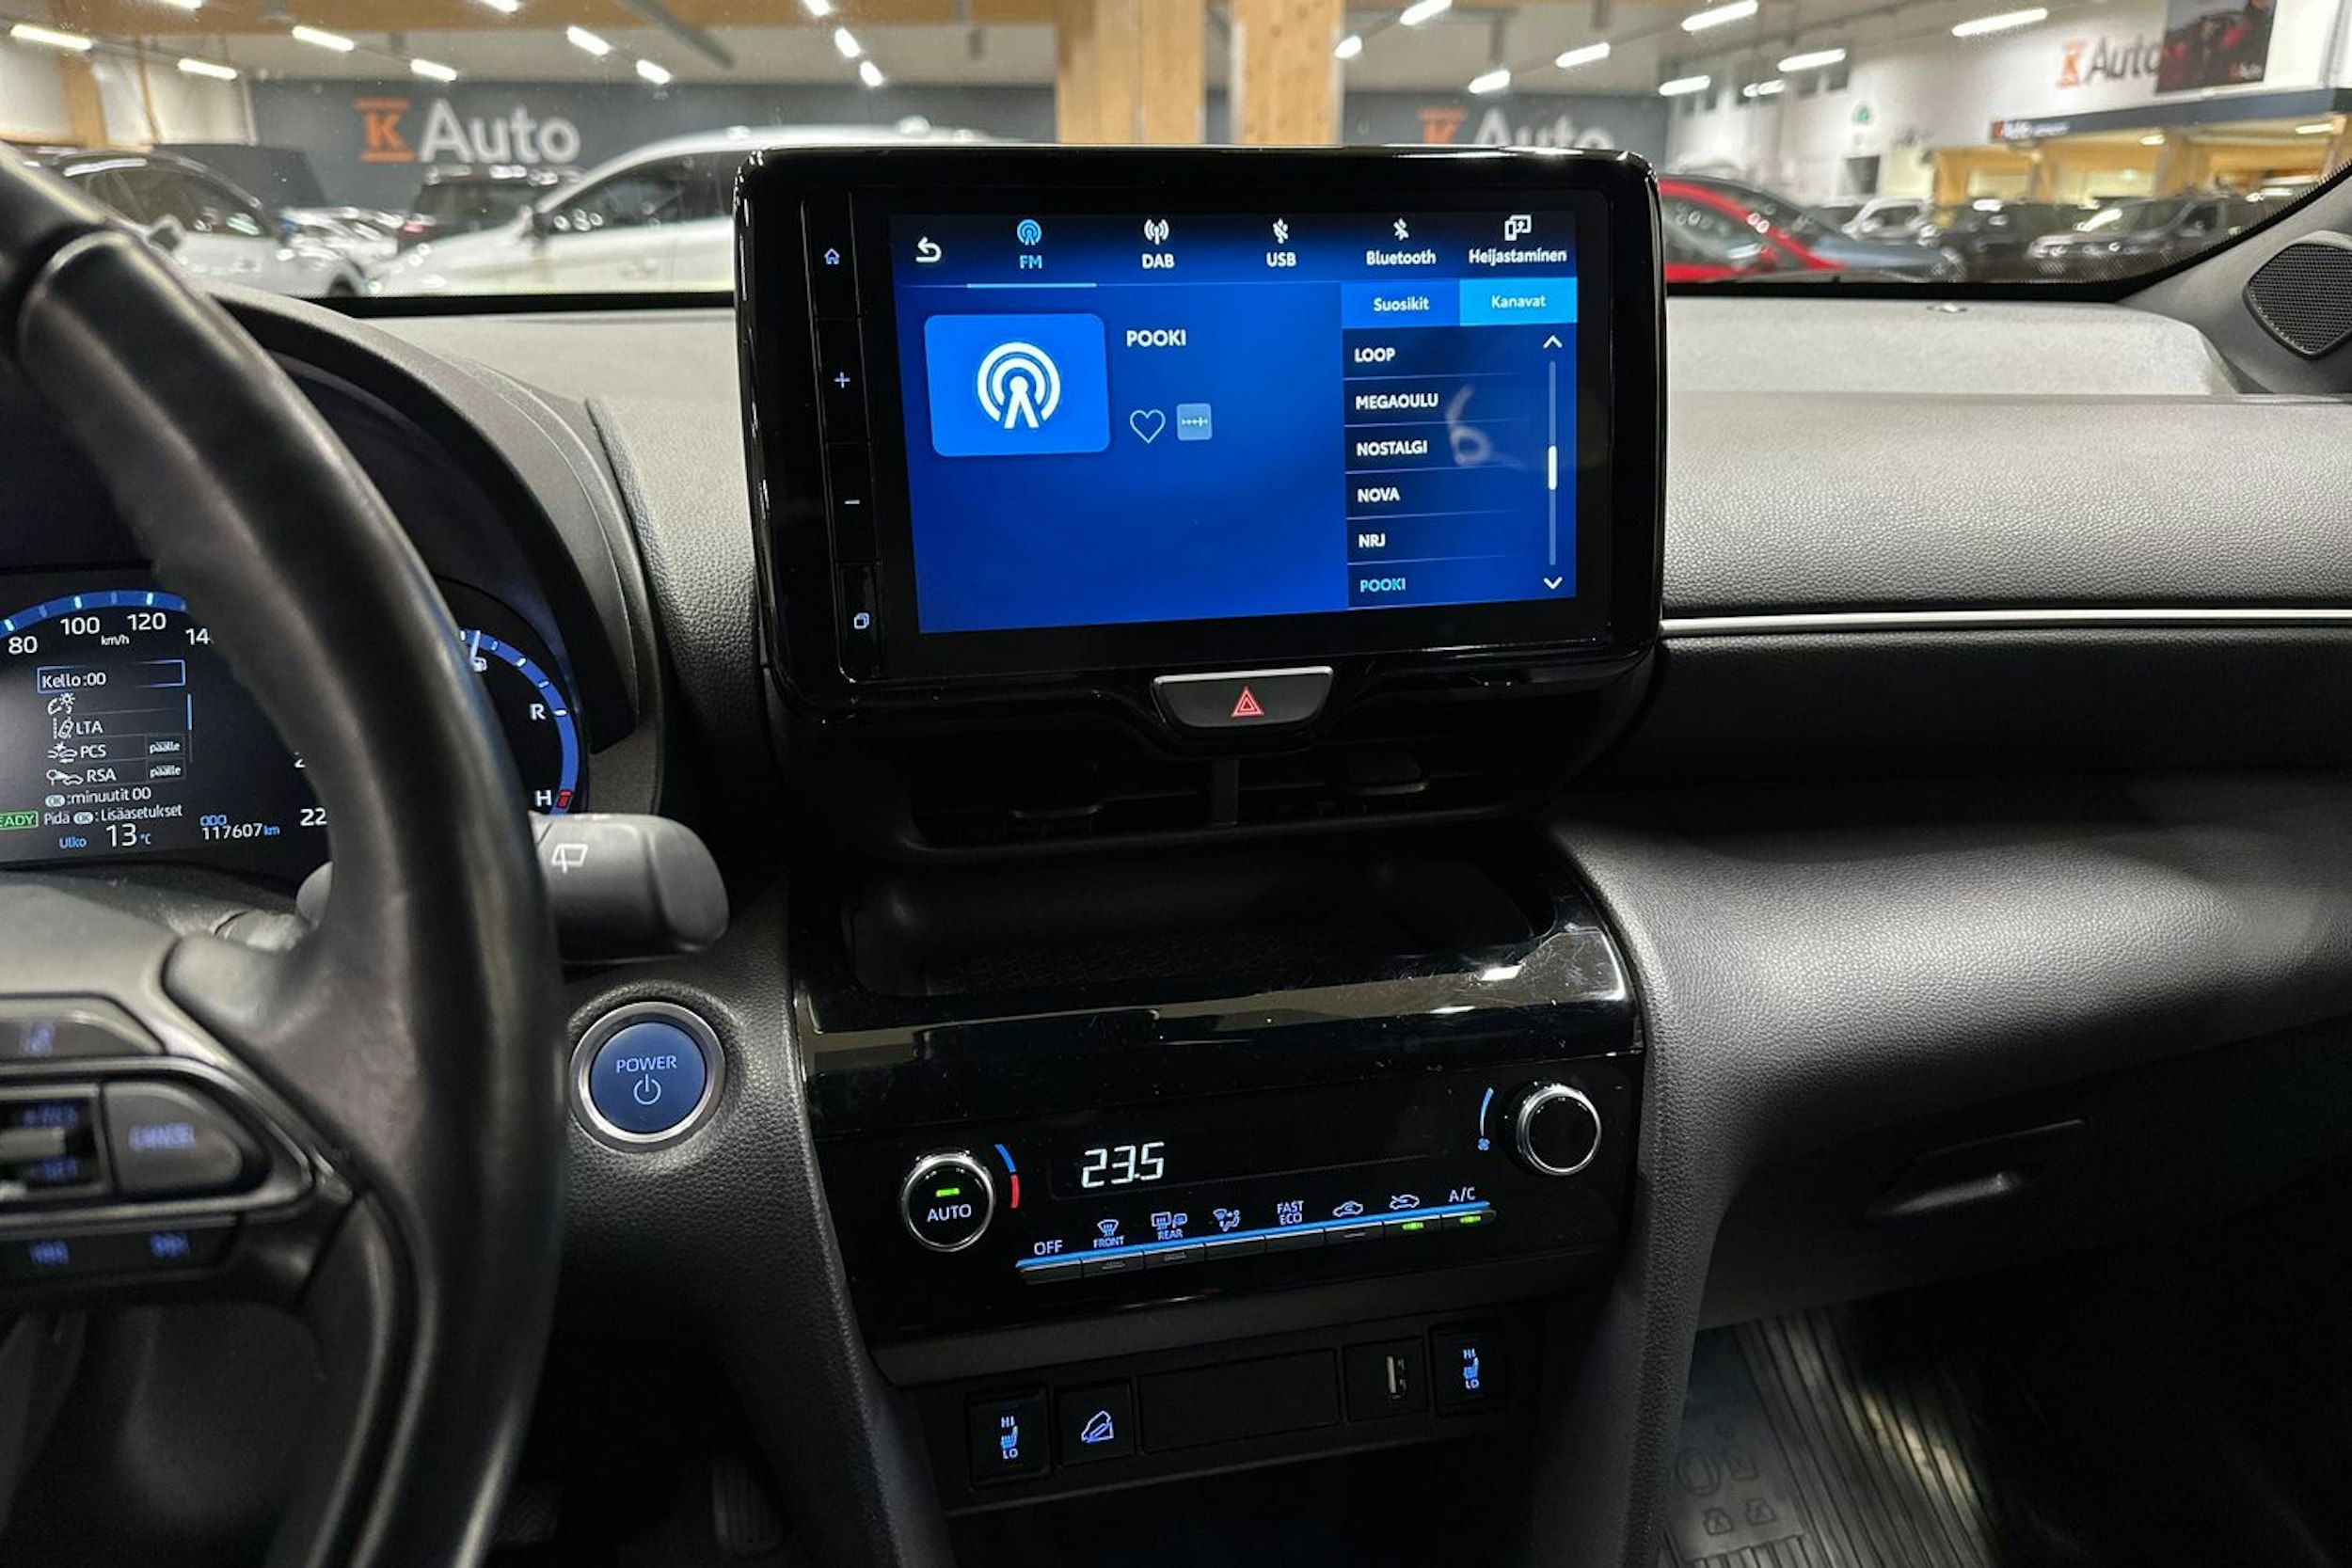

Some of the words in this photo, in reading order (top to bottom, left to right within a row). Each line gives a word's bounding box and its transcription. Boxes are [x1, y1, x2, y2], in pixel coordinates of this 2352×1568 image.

[2086, 35, 2163, 85] Auto
[420, 98, 580, 164] Auto
[1019, 255, 1042, 270] FM
[1141, 253, 1175, 269] DAB
[1266, 251, 1296, 267] USB
[1366, 248, 1437, 265] Bluetooth
[1468, 246, 1567, 266] Heijastaminen
[1374, 294, 1429, 312] Suosikit
[1491, 293, 1546, 309] Kanavat
[1126, 329, 1186, 347] POOKI
[1354, 347, 1395, 363] LOOP
[1355, 392, 1439, 410] MEGAOULU
[1356, 439, 1428, 456] NOSTALGI
[1357, 487, 1401, 502] NOVA
[1358, 532, 1386, 548] NRJ
[1359, 577, 1406, 593] POOKI
[60, 616, 101, 636] 100
[126, 612, 167, 631] 120
[101, 634, 130, 646] km/h
[185, 627, 211, 645] 14
[8, 636, 39, 655] 80
[530, 703, 547, 721] R
[76, 721, 103, 736] LTA
[80, 744, 106, 758] PCS
[87, 768, 117, 783] RSA
[534, 790, 553, 806] H
[44, 812, 71, 826] Pidä
[101, 804, 183, 822] Lisäasetukset
[199, 815, 228, 826] ODO
[299, 807, 327, 827] 22
[59, 836, 87, 849] Ulko
[105, 823, 137, 847] 13
[201, 823, 262, 840] 117607
[263, 825, 280, 836] km
[615, 1054, 677, 1073] POWER
[1449, 1186, 1476, 1202] A/C
[927, 1204, 972, 1222] AUTO
[1277, 1200, 1305, 1214] FAST
[1279, 1213, 1303, 1225] ECO
[1093, 1235, 1125, 1248] FRONT
[1157, 1228, 1184, 1241] REAR
[1034, 1240, 1063, 1256] OFF
[1463, 1348, 1476, 1360] HI
[1465, 1379, 1480, 1389] LO
[1001, 1415, 1015, 1428] HI
[1002, 1449, 1018, 1459] LO
